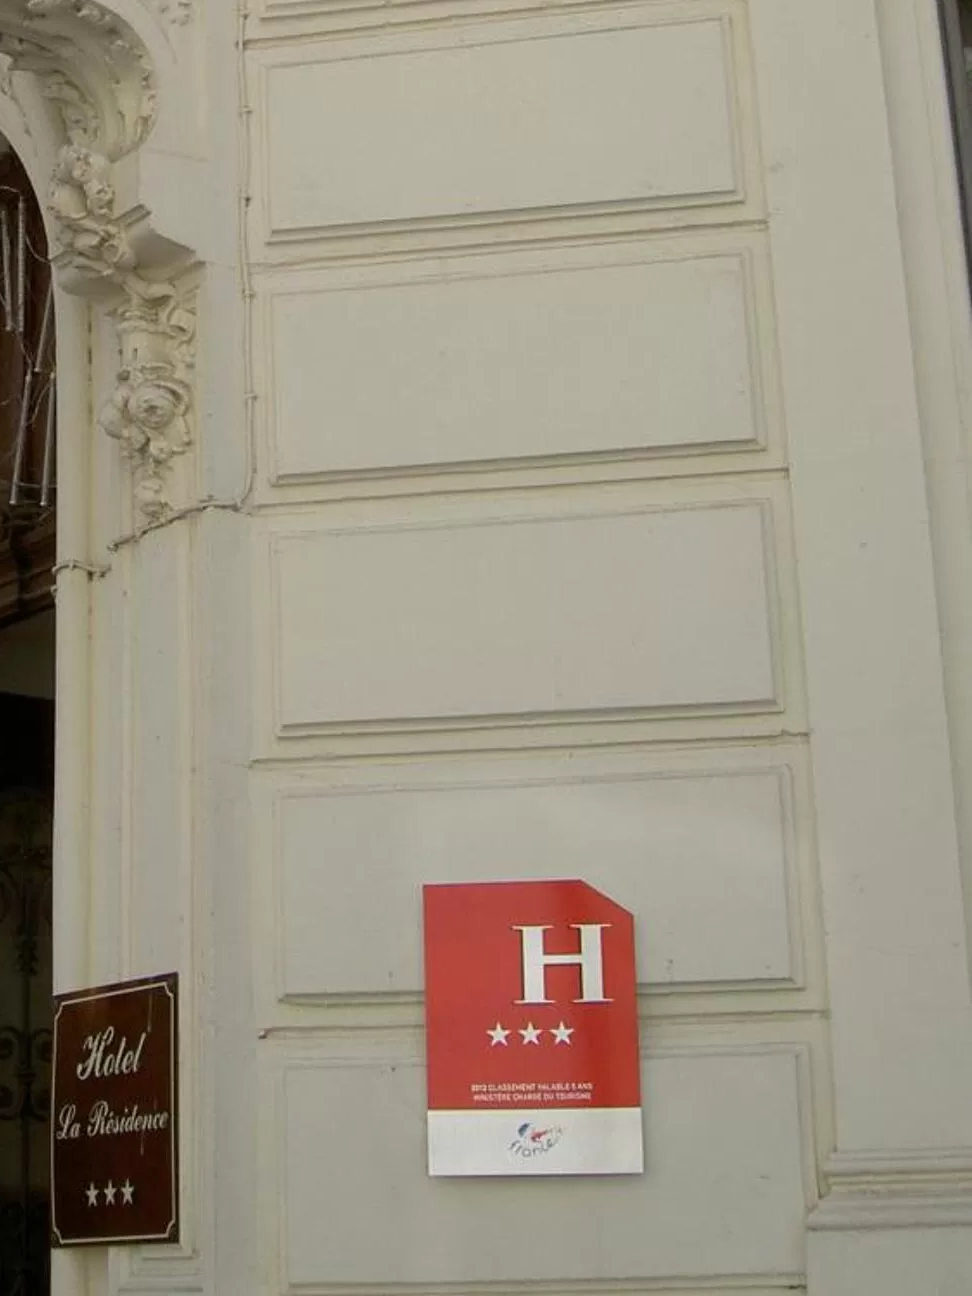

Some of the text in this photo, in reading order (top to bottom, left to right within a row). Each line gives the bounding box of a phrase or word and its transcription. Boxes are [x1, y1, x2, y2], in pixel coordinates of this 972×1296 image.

[512, 924, 614, 1004] H
[77, 1025, 147, 1080] Hotel
[488, 1083, 536, 1092] CLASSEMENT
[578, 1082, 593, 1091] ANS
[543, 1092, 554, 1101] DU
[556, 1091, 591, 1101] TOURISME
[56, 1100, 169, 1140] La Résidence
